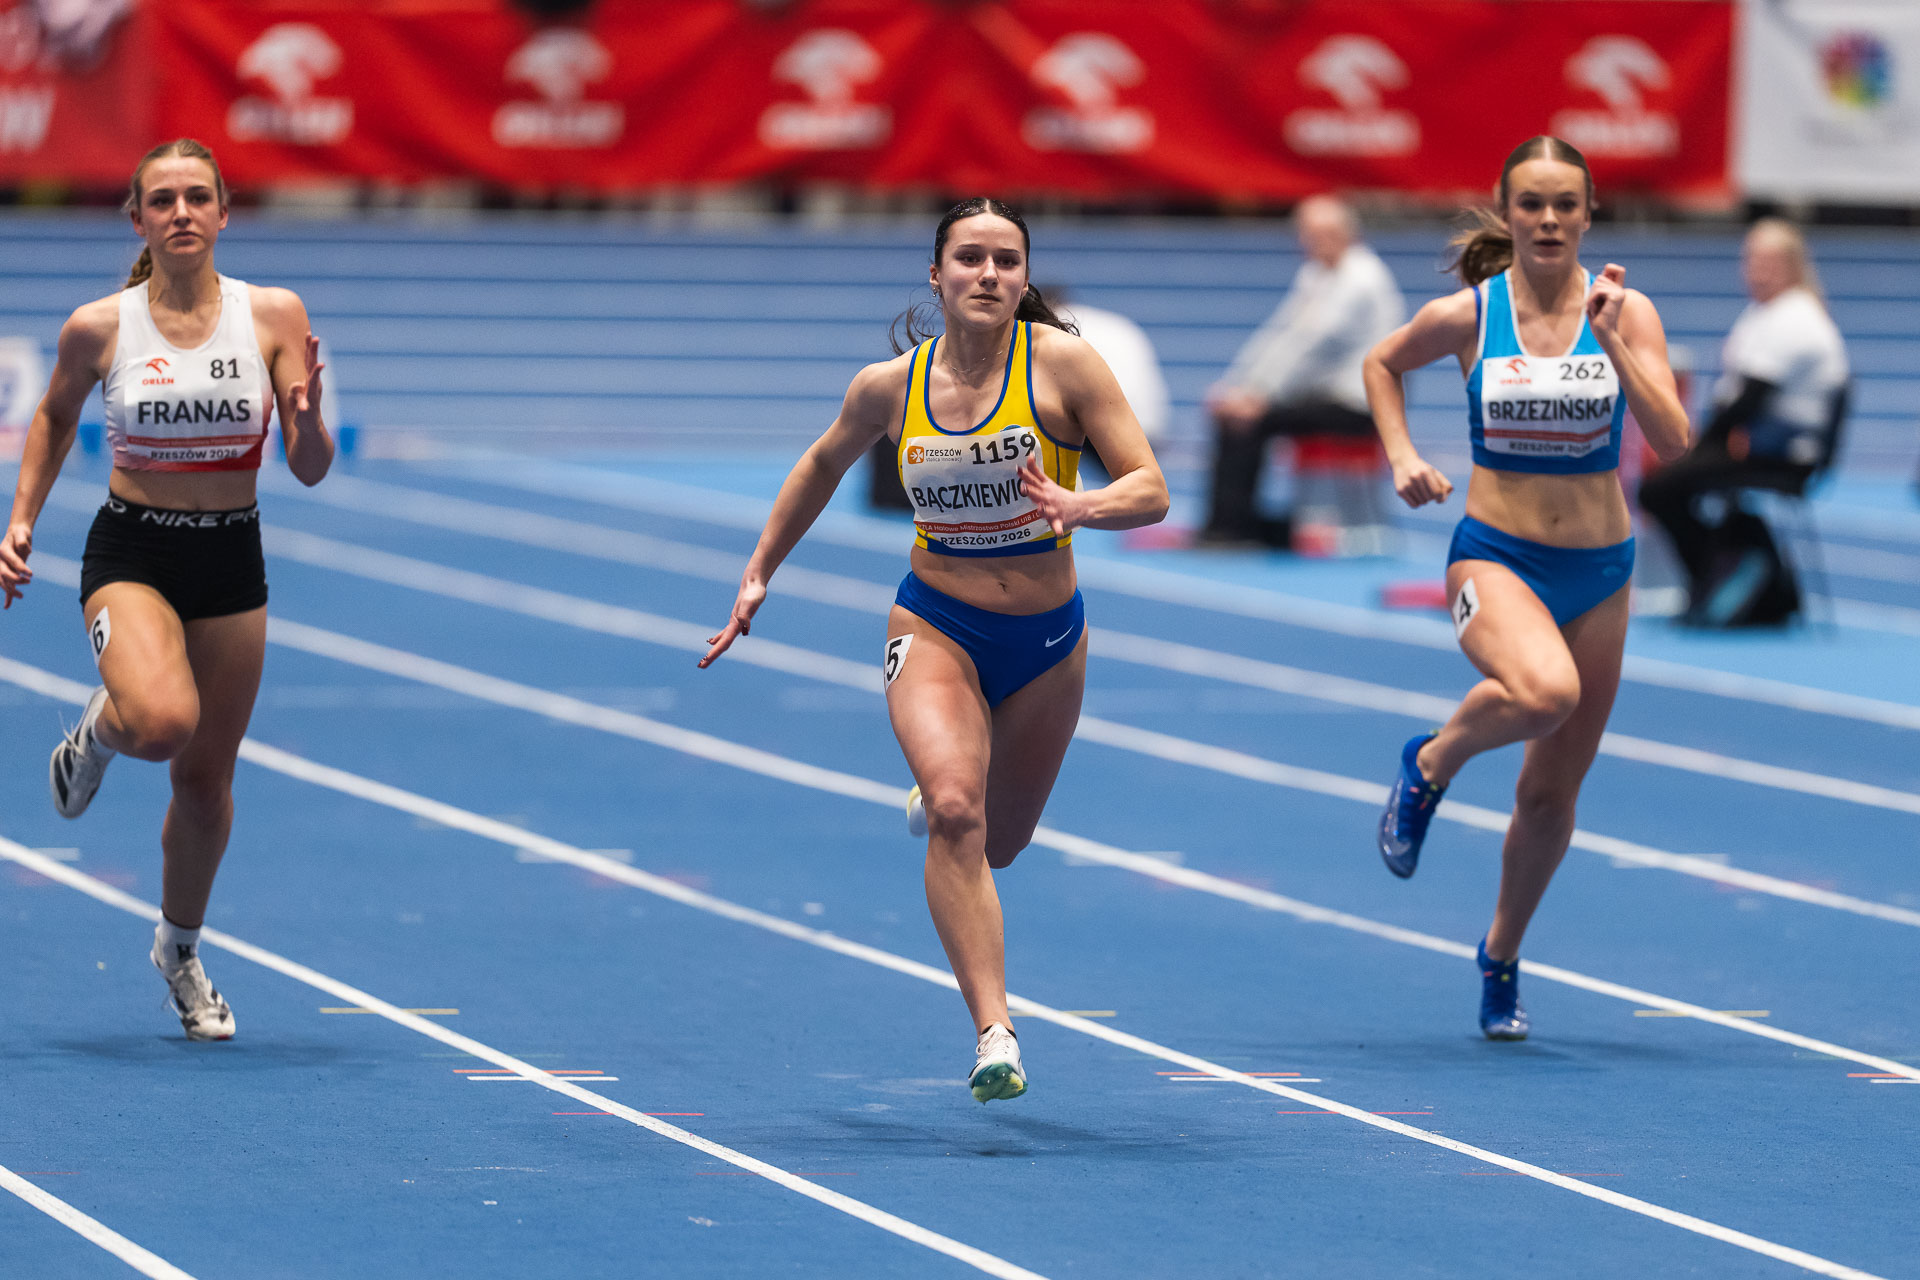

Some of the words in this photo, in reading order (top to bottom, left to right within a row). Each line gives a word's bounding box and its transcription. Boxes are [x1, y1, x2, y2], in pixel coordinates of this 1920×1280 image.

[210, 358, 241, 379] 81
[1559, 361, 1606, 381] 262
[142, 378, 174, 386] ORLEN
[137, 399, 251, 425] FRANAS
[1488, 394, 1612, 421] BRZEZIŃSKA
[151, 449, 207, 460] RZESZÓW
[209, 448, 238, 459] 2026
[925, 447, 962, 457] rzeszów
[969, 433, 1037, 465] 1159
[911, 477, 1029, 513] BĄCZKIEWIC
[140, 509, 222, 528] NIKE
[1000, 519, 1020, 529] Polski
[1020, 514, 1032, 524] U18
[940, 534, 998, 546] RZESZÓW
[1001, 528, 1032, 543] 2026
[1459, 591, 1472, 624] 4
[92, 619, 104, 656] 6
[886, 637, 903, 682] 5
